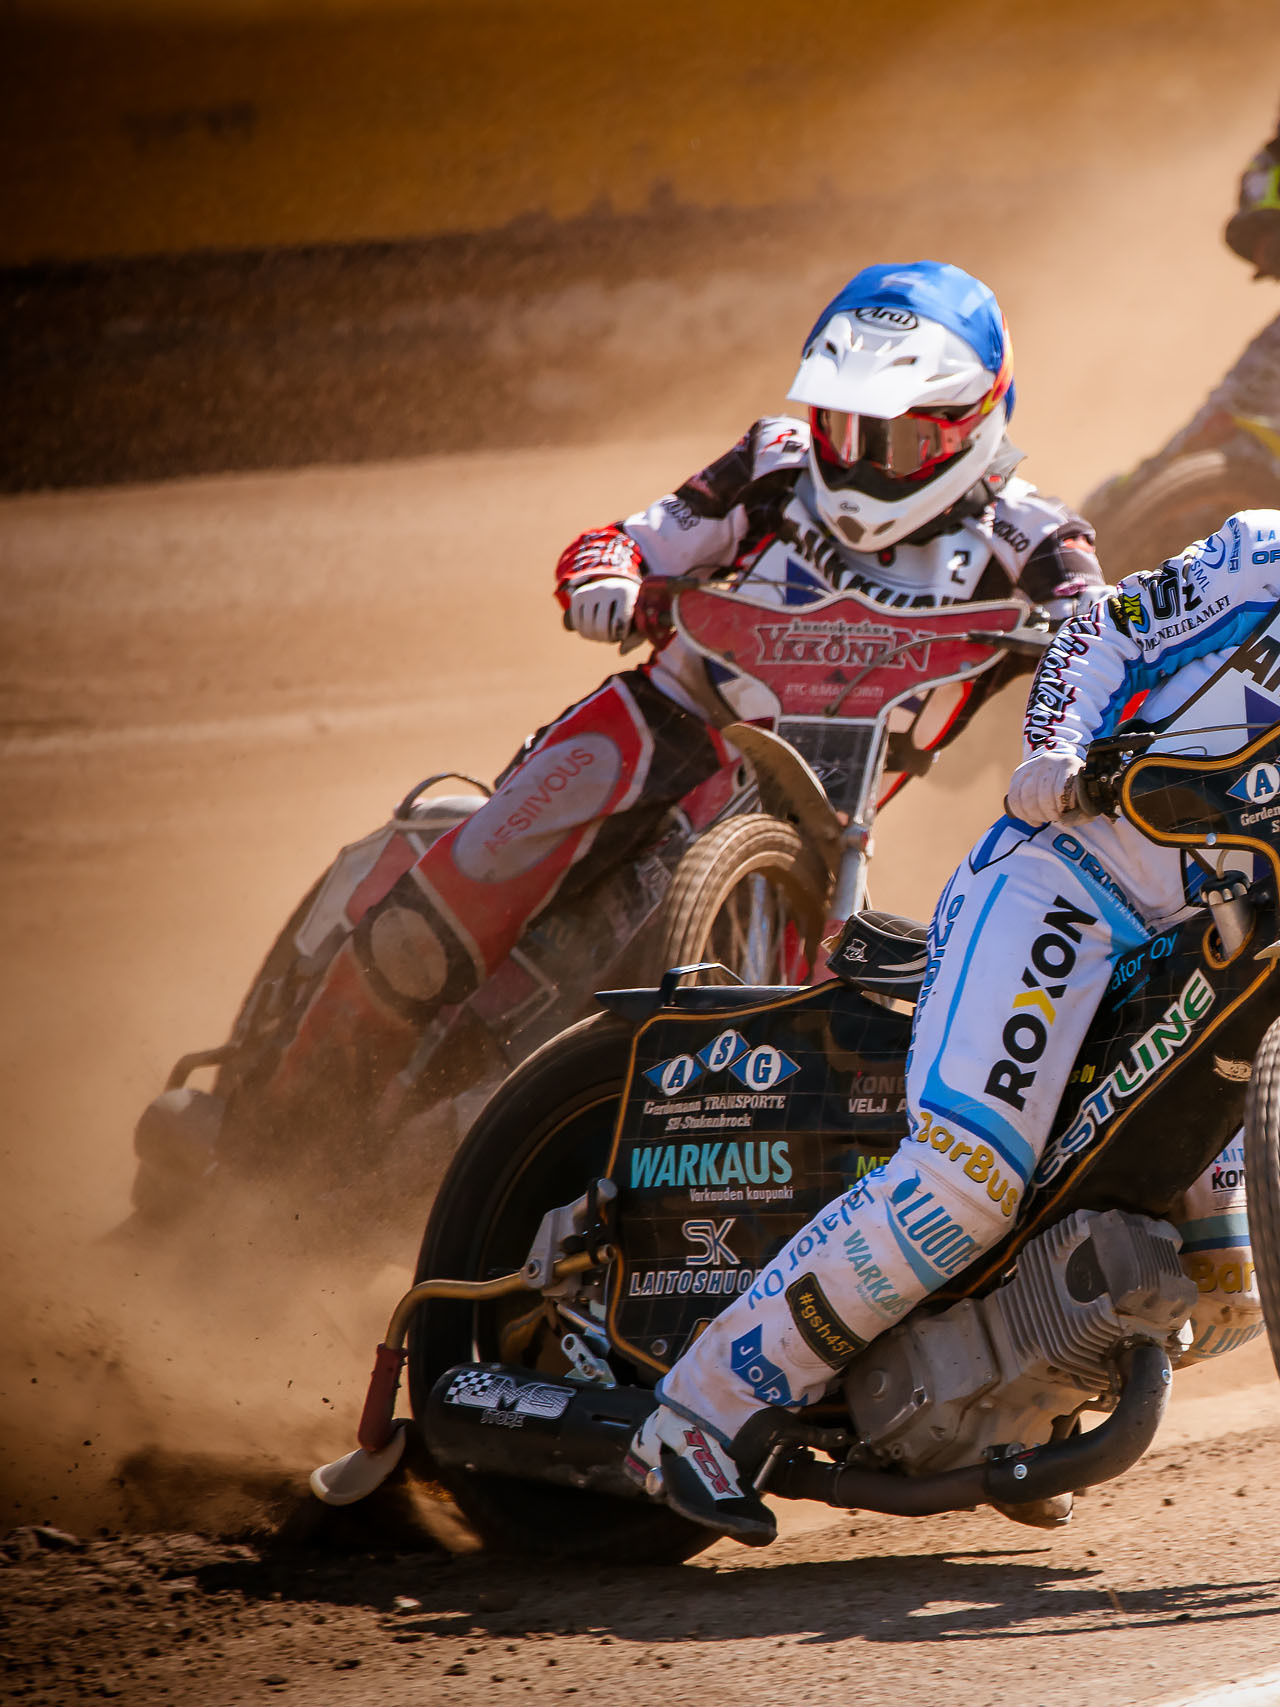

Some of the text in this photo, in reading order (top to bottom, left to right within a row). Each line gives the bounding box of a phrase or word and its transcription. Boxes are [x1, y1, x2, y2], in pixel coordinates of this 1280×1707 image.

[1150, 930, 1179, 961] Oy
[984, 894, 1099, 1113] ROXON
[704, 1094, 786, 1111] TRANSPORTE
[630, 1140, 793, 1189] WARKAUS
[689, 1185, 794, 1203] Varkauden kaupunki
[682, 1217, 741, 1266] SK
[628, 1268, 764, 1297] LAITOSHUO
[798, 1291, 856, 1358] #gsh457
